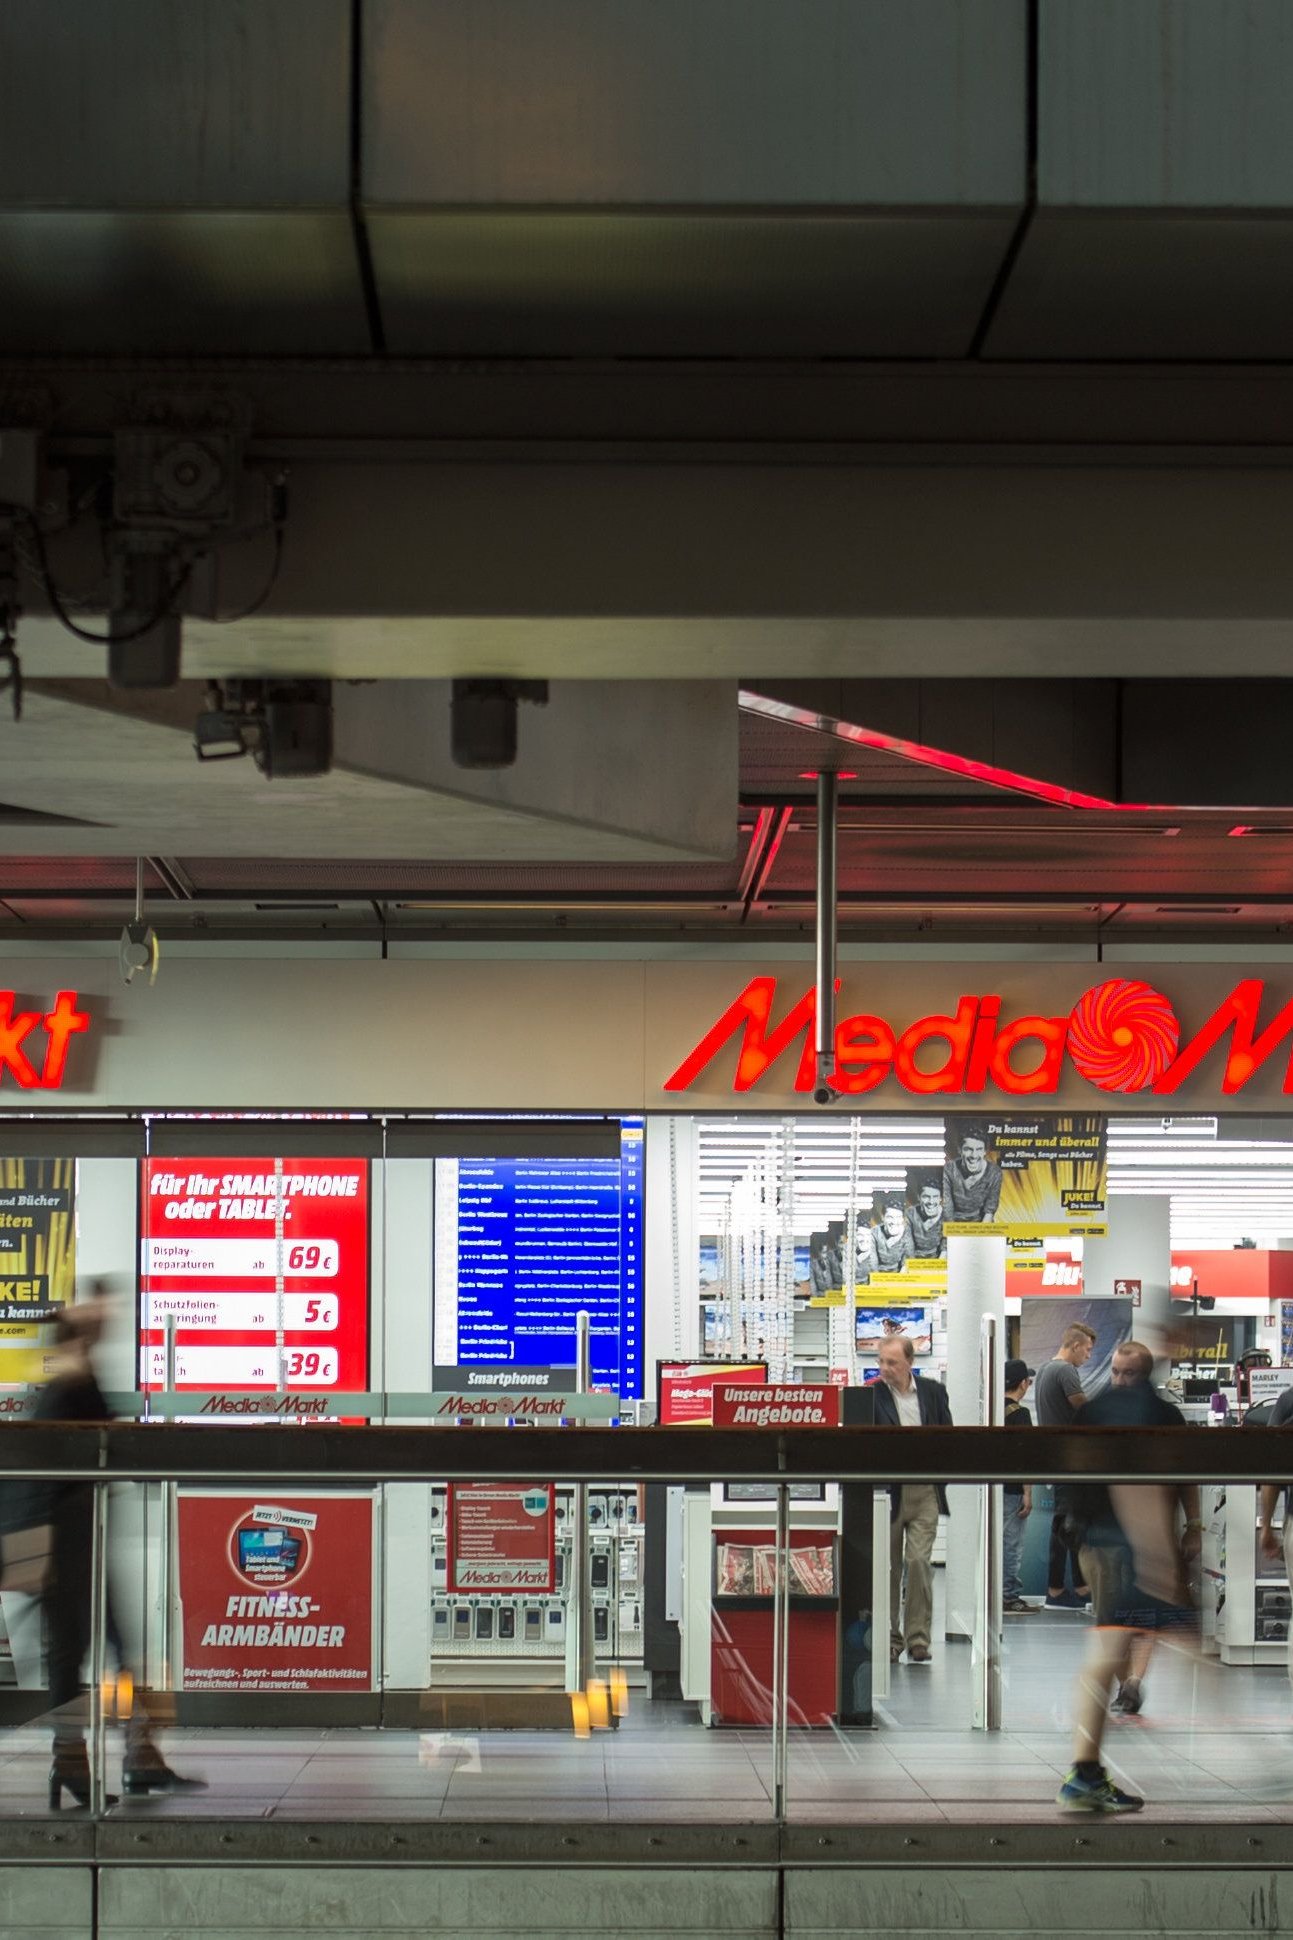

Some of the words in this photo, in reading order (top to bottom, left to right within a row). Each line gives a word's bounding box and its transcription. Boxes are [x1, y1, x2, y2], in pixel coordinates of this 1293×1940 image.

[663, 976, 1068, 1095] Media
[988, 1124, 1002, 1134] Du
[1004, 1124, 1039, 1134] kannst
[995, 1136, 1033, 1147] immer
[1035, 1137, 1057, 1147] und
[1060, 1136, 1100, 1147] überall
[150, 1173, 186, 1196] für
[186, 1174, 220, 1196] Ihr
[220, 1174, 359, 1197] SMARTPHONE
[18, 1194, 60, 1206] Bücher
[165, 1198, 217, 1220] oder
[218, 1198, 292, 1220] TABLET.
[153, 1246, 193, 1257] Display-
[153, 1260, 214, 1270] reparaturen
[252, 1260, 265, 1269] ab
[153, 1300, 220, 1310] Schutzfolien-
[153, 1315, 217, 1324] auringung
[252, 1314, 264, 1323] ab
[252, 1366, 264, 1375] ab
[468, 1372, 549, 1387] Smartphones
[723, 1388, 772, 1403] Unsere
[774, 1387, 823, 1403] besten
[200, 1395, 260, 1414] Media
[273, 1395, 329, 1414] Markt
[437, 1396, 497, 1414] Media
[512, 1396, 567, 1414] Markt
[733, 1405, 826, 1427] Angebote.
[460, 1570, 501, 1583] Media
[511, 1570, 547, 1583] Markt
[225, 1596, 320, 1618] FITNESS-
[201, 1621, 345, 1647] ARMBÄNDER
[184, 1667, 241, 1678] Bewegungs-,
[242, 1668, 270, 1678] Sport-
[271, 1668, 289, 1677] und
[290, 1668, 367, 1678] Schlafaktivitäten
[184, 1680, 239, 1689] aufzeichnen
[240, 1680, 258, 1689] und
[259, 1680, 309, 1690] auswerten.
